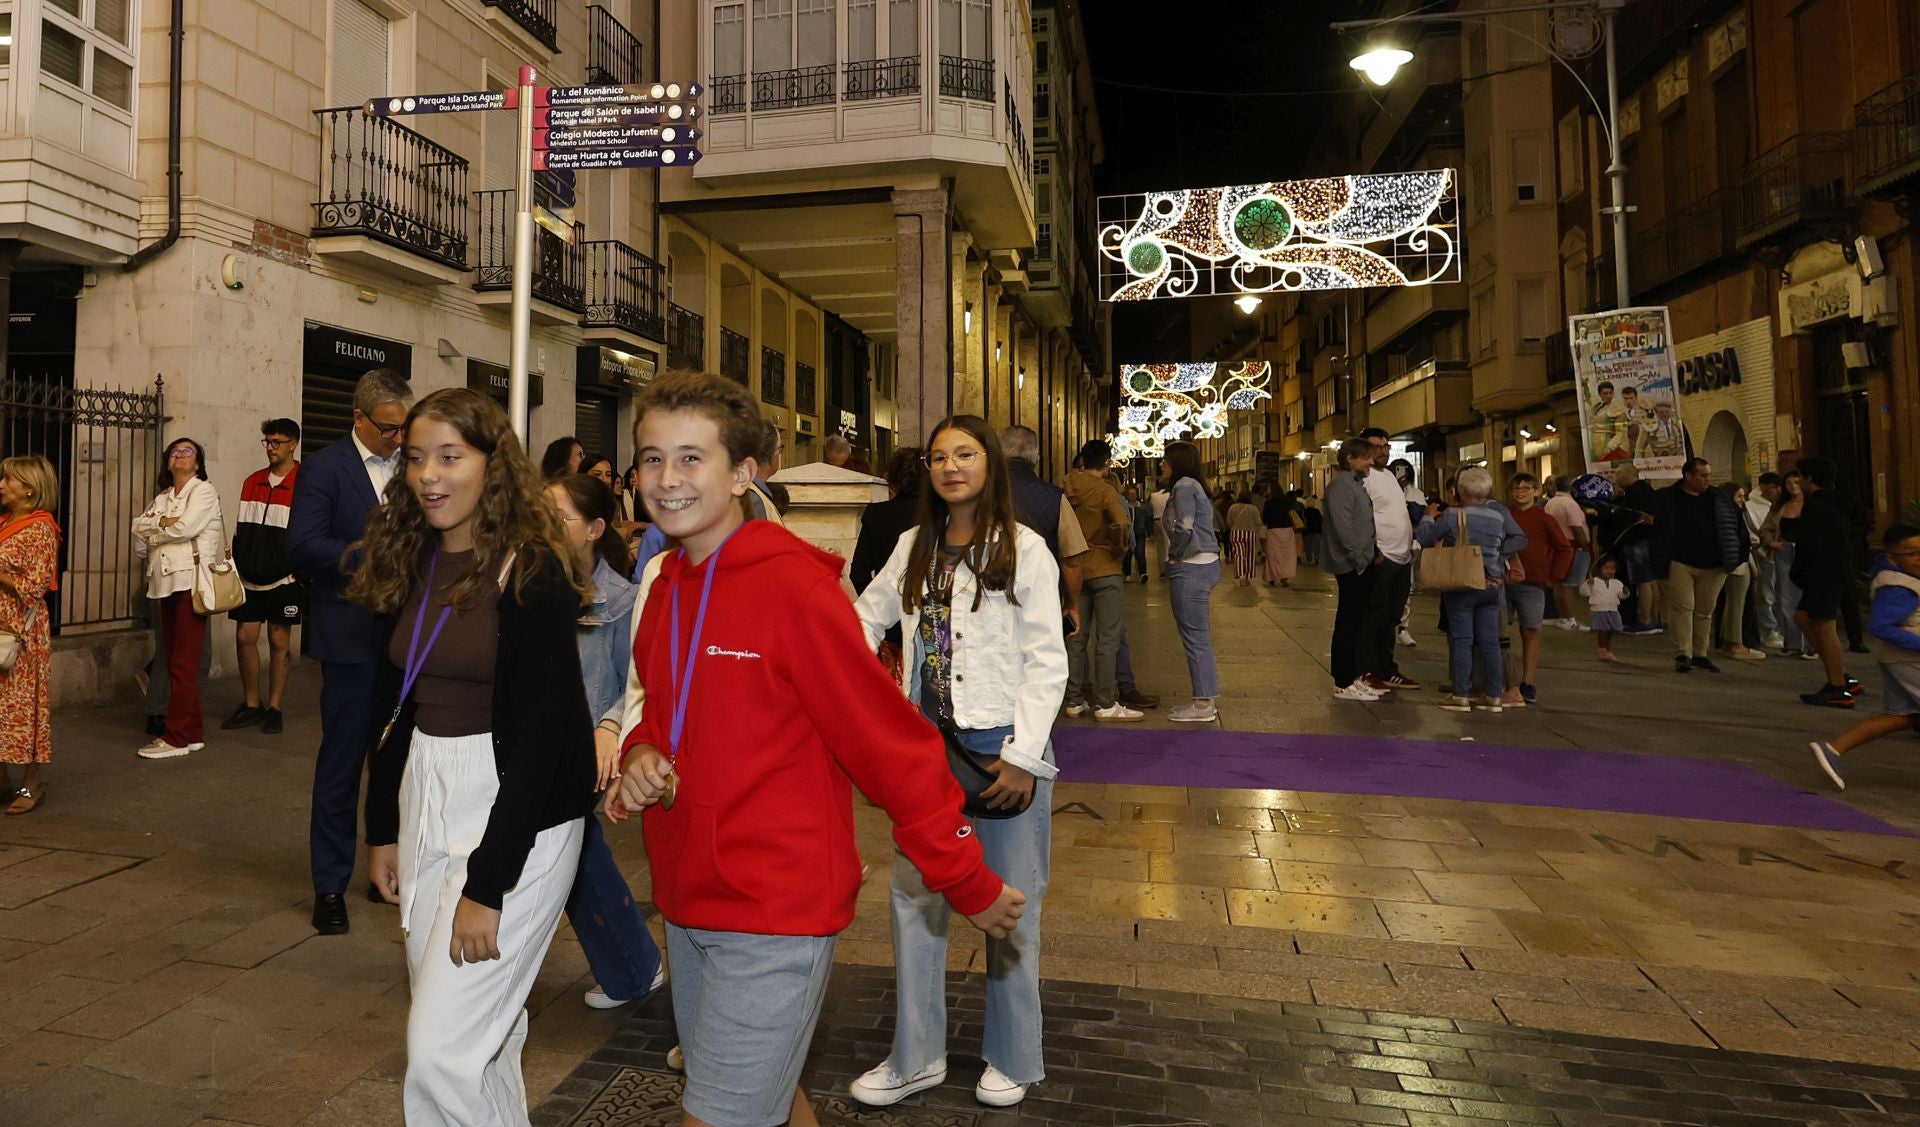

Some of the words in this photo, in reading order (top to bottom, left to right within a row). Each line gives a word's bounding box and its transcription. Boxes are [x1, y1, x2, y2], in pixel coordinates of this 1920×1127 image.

[551, 89, 559, 97] P.
[568, 87, 582, 96] del
[583, 86, 624, 96] Románico
[418, 97, 447, 106] Parque
[448, 95, 461, 103] Isla
[462, 94, 478, 102] Dos
[479, 92, 504, 103] Aguas
[551, 97, 591, 105] Romanesque
[591, 95, 629, 103] Information
[450, 103, 470, 111] Aguas
[551, 110, 580, 118] Parque
[581, 107, 594, 117] del
[596, 106, 619, 116] Salón
[620, 106, 632, 115] de
[633, 105, 658, 115] Isabel
[659, 105, 666, 113] II
[551, 118, 568, 126] Salón
[550, 130, 581, 140] Colegio
[583, 129, 619, 138] Modesto
[621, 128, 659, 136] Lafuente
[578, 138, 606, 146] Lafuente
[606, 137, 628, 145] School
[549, 153, 578, 161] Parque
[579, 151, 608, 160] Huerta
[610, 150, 621, 159] de
[622, 149, 658, 158] Guadián
[549, 161, 571, 169] Huerta
[580, 160, 607, 168] Guadián
[608, 159, 623, 167] Park
[335, 340, 386, 364] FELICIANO
[1677, 346, 1743, 397] CASA
[706, 644, 761, 661] Champion
